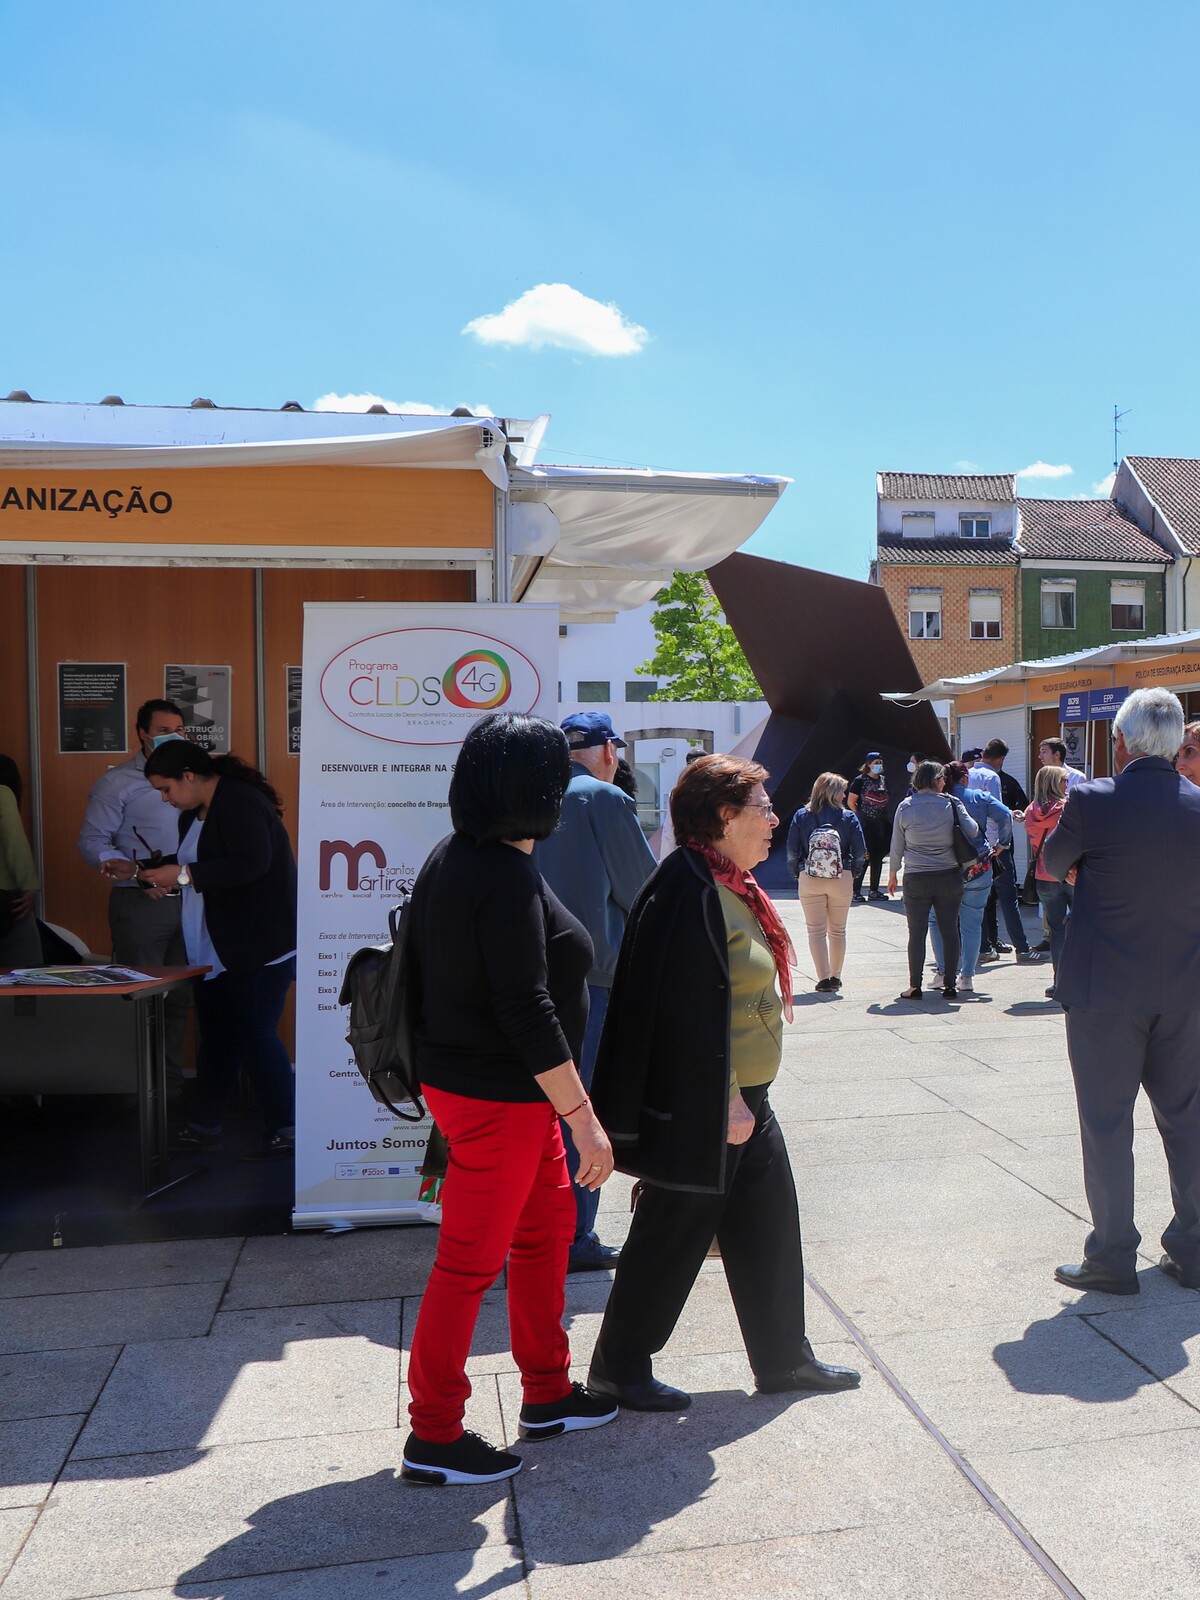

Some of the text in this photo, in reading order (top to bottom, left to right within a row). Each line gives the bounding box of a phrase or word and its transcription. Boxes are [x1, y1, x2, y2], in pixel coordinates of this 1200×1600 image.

[1, 485, 173, 519] ANIZAÇÃO
[349, 659, 399, 674] Programa
[1157, 665, 1181, 676] SEGURANÇA
[349, 666, 496, 706] CLDS 4G
[1103, 694, 1114, 703] EPP
[321, 764, 379, 772] DESENVOLVER
[382, 764, 387, 772] E
[391, 764, 431, 772] INTEGRAR
[434, 764, 447, 772] NA
[336, 800, 346, 808] de
[346, 800, 387, 809] Intervenção:
[387, 800, 416, 808] concelho
[417, 800, 426, 808] de
[386, 862, 415, 875] santos
[318, 932, 337, 940] Eixos
[337, 932, 347, 940] de
[329, 1070, 360, 1078] Centro
[326, 1139, 377, 1151] Juntos
